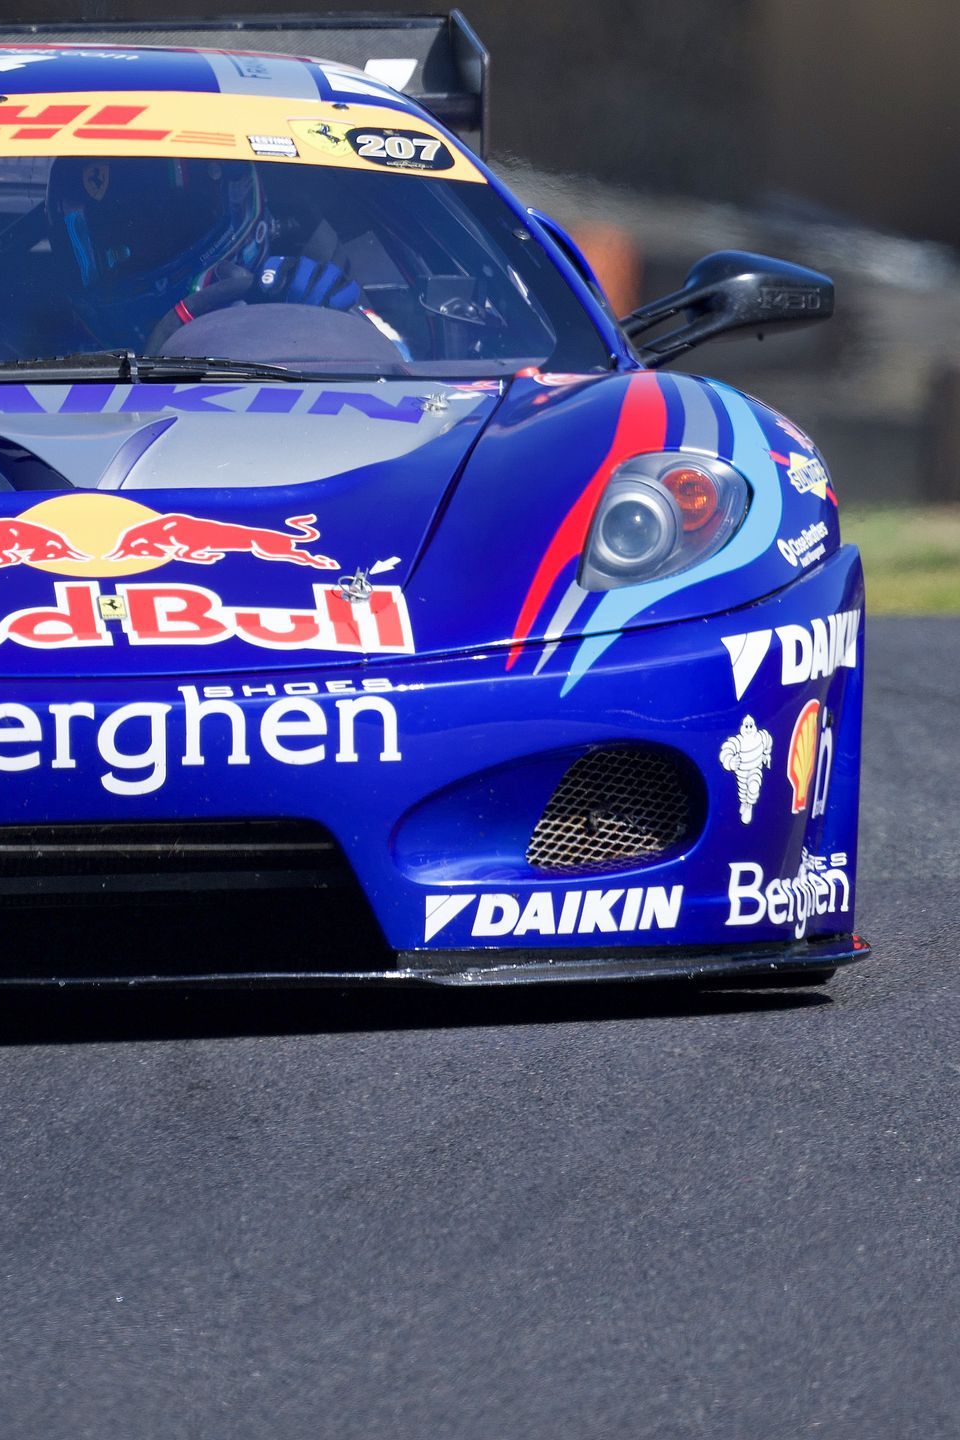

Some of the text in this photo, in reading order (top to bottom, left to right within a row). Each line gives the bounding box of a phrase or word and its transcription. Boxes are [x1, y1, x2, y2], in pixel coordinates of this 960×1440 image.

[356, 134, 441, 162] 207
[116, 582, 415, 655] Bull
[472, 885, 684, 937] DAIKIN
